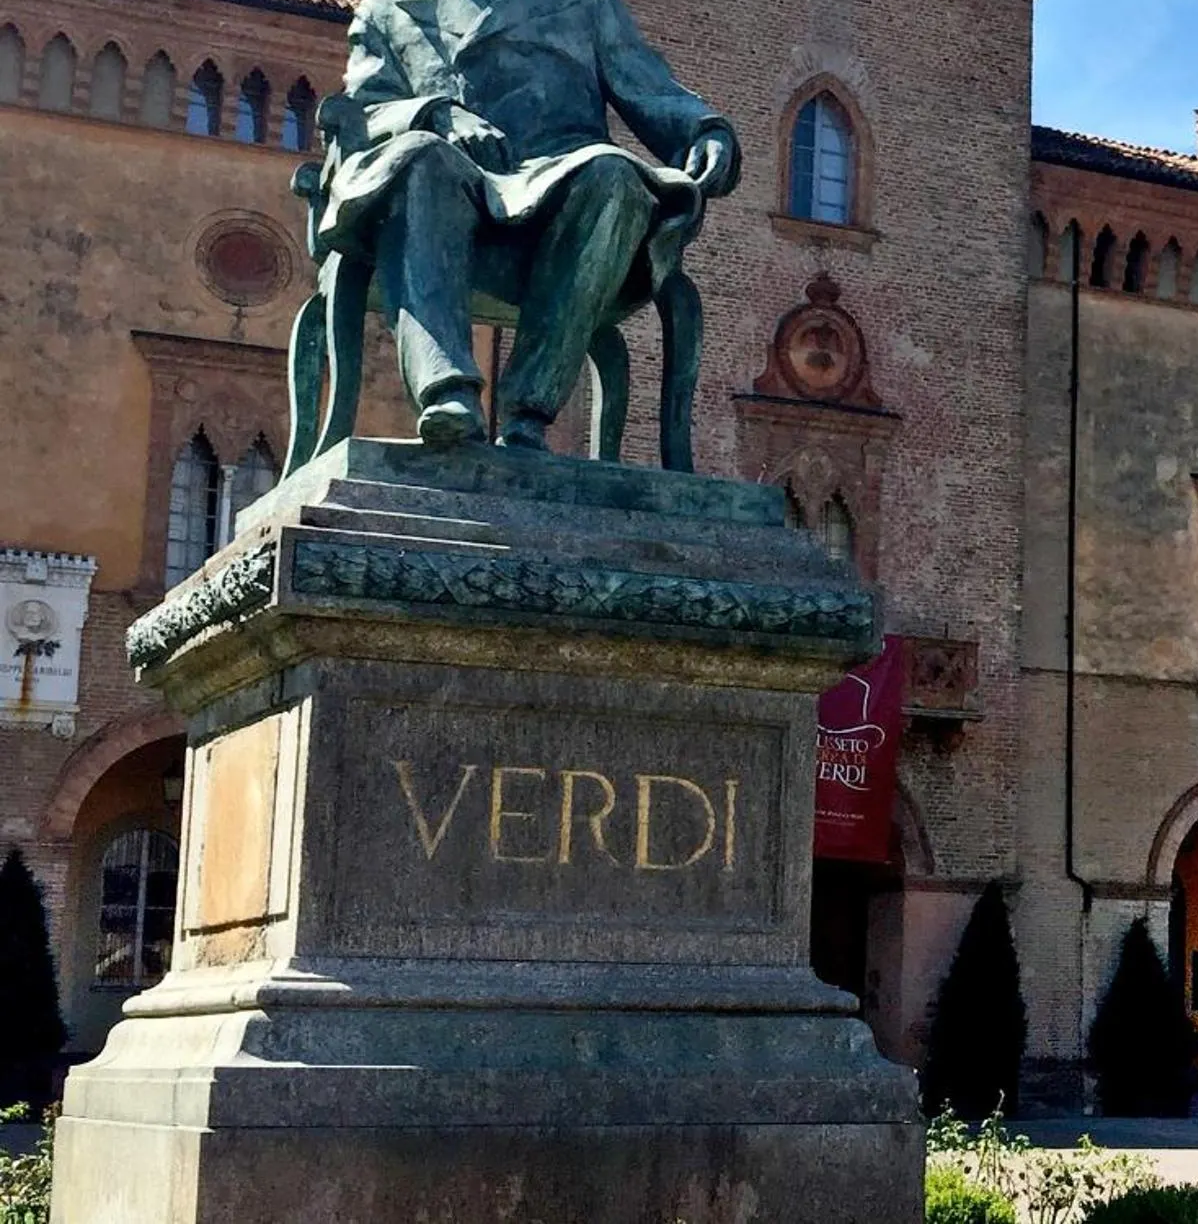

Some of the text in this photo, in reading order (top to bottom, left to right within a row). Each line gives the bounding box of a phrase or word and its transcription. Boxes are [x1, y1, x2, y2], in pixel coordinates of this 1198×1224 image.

[815, 733, 869, 753] USSETO
[815, 760, 871, 791] ERDI
[391, 760, 740, 873] VERDI
